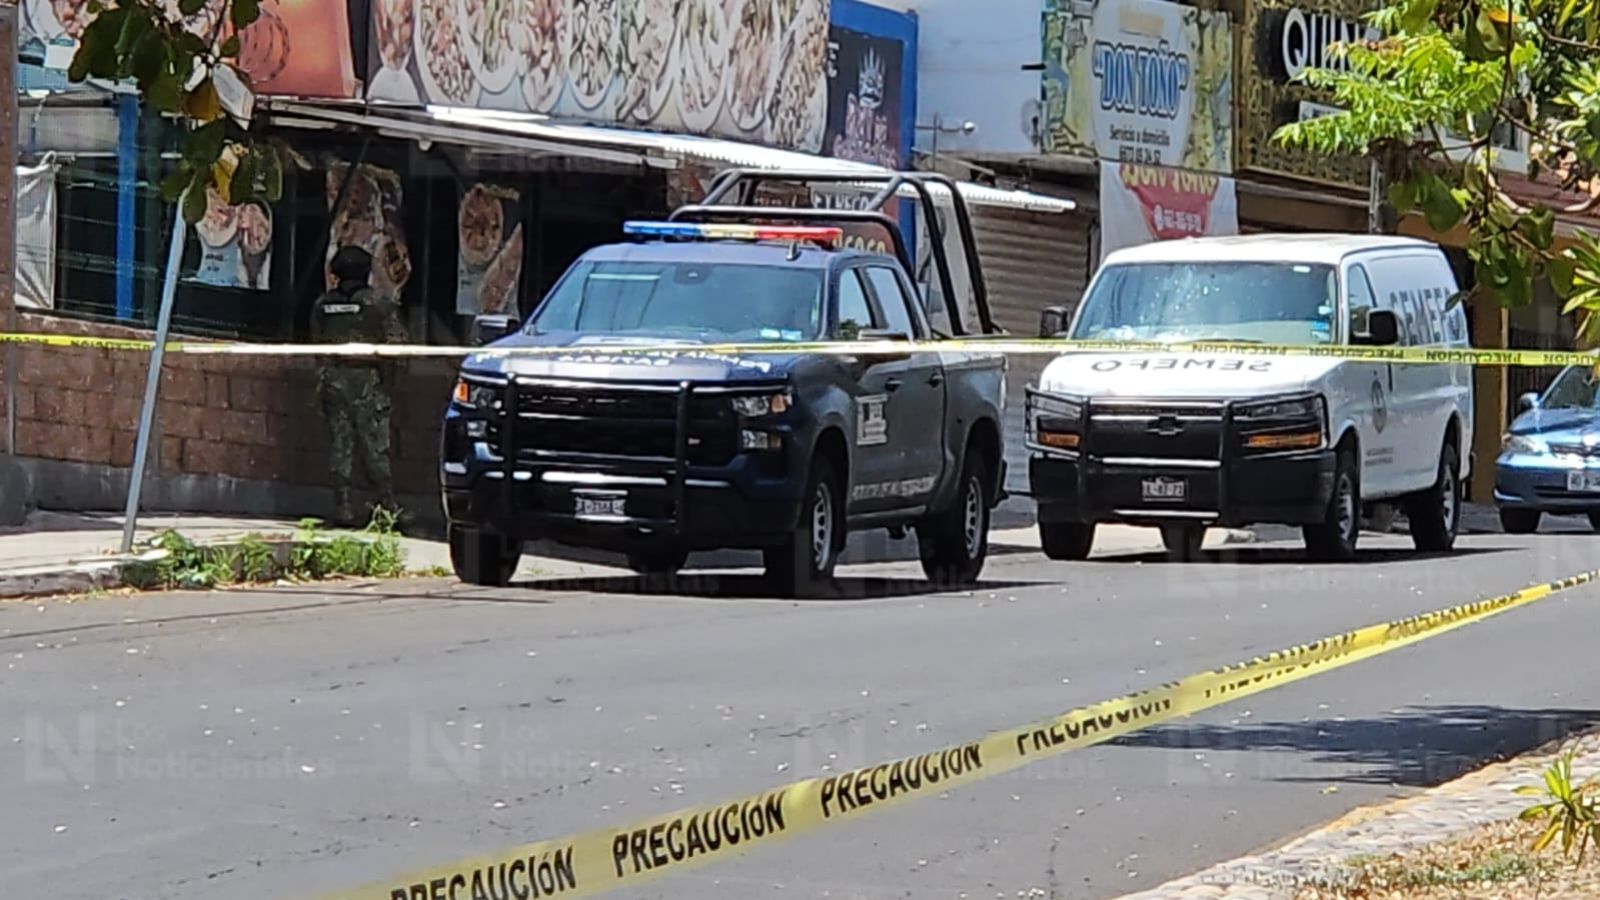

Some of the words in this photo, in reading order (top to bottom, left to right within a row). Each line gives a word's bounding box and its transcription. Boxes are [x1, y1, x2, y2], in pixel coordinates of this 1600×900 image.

[1109, 124, 1135, 142] Servicio
[1142, 128, 1170, 147] domicilio
[612, 790, 786, 877] PRECAUCIÓN
